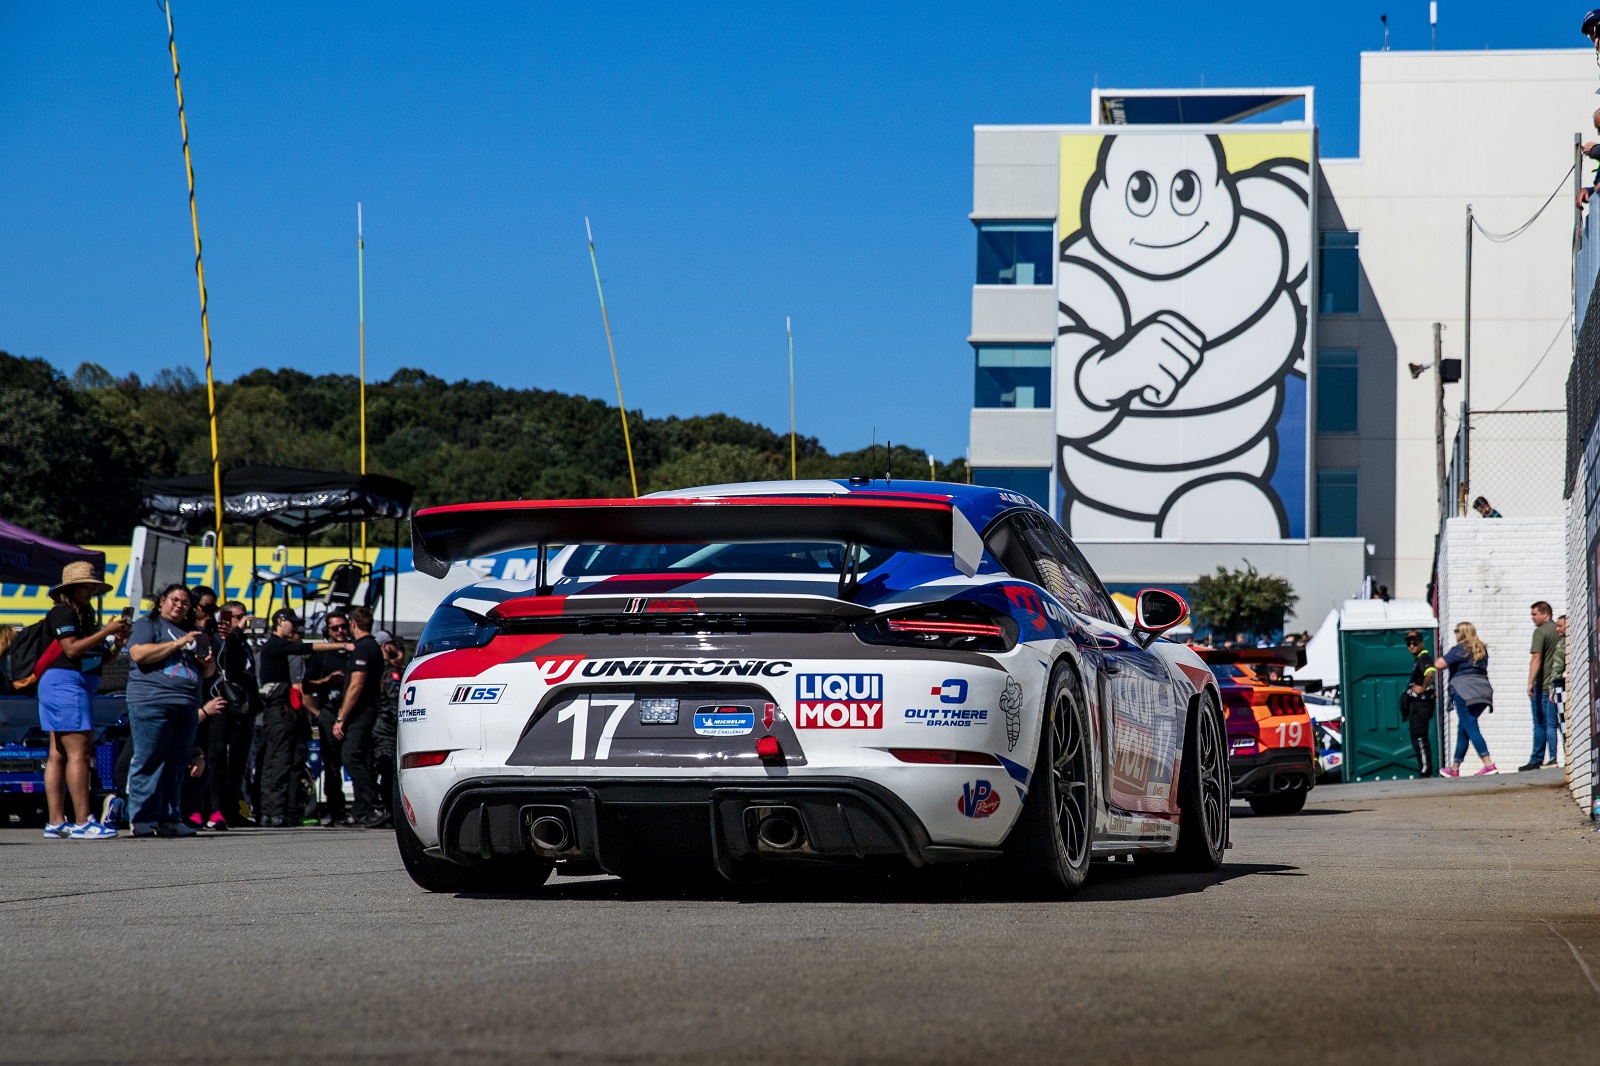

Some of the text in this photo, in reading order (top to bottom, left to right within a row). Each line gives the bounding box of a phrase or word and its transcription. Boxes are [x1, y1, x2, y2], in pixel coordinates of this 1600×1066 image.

[646, 599, 699, 613] IMSA
[581, 659, 793, 677] UNITRONIC
[470, 688, 500, 700] GS
[799, 675, 879, 701] LIQUI
[406, 708, 426, 716] THERE
[800, 702, 881, 728] MOLY
[905, 709, 988, 720] OUT THERE
[557, 693, 635, 761] 17
[1275, 721, 1303, 748] 19
[1155, 719, 1172, 778] 17
[963, 779, 992, 818] VP
[976, 800, 1001, 814] Racing
